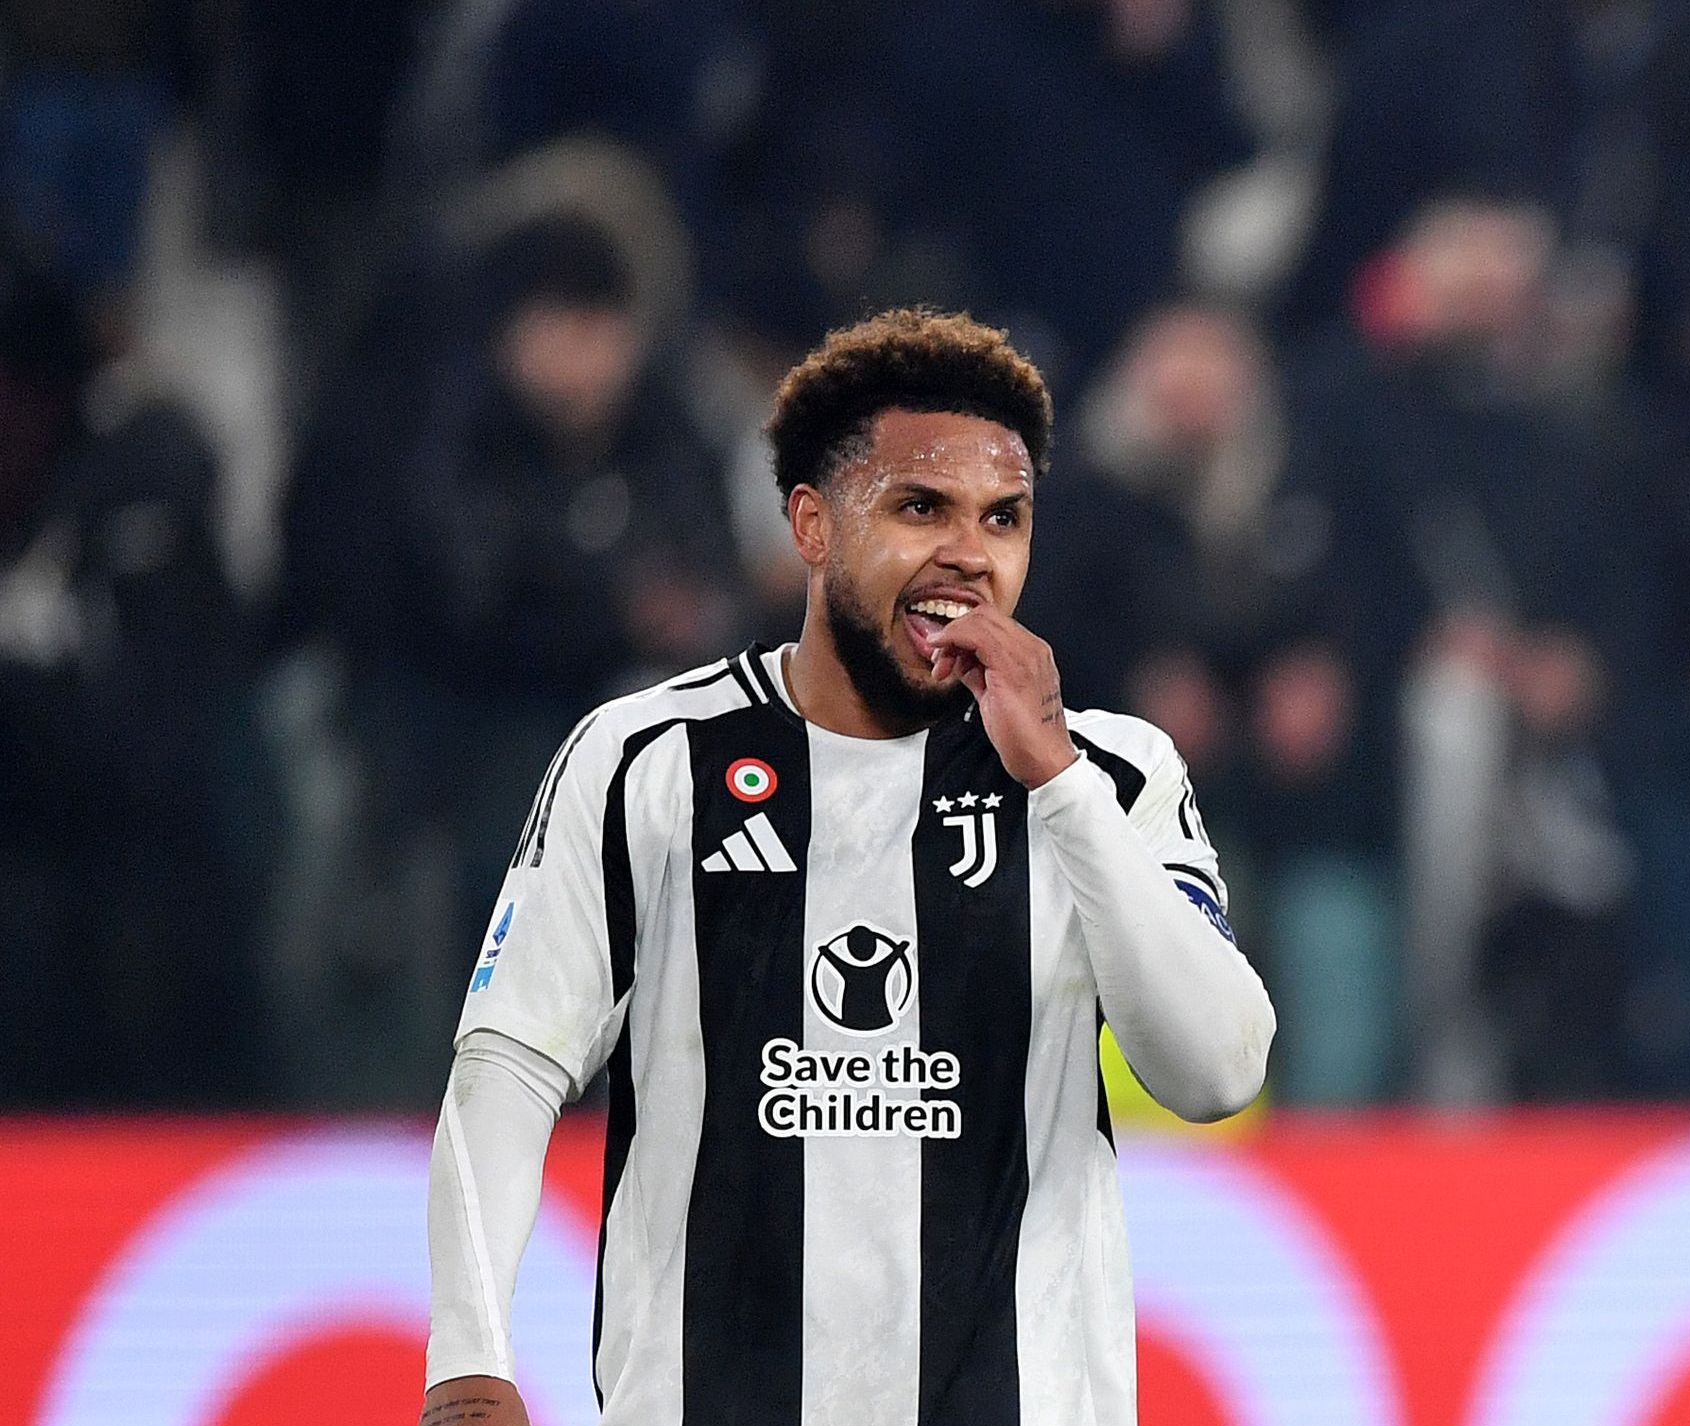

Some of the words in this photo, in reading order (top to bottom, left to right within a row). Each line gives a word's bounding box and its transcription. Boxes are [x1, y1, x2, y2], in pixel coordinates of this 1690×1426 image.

[768, 1045, 870, 1081] Save
[882, 1047, 954, 1082] the
[764, 1094, 955, 1132] Children
